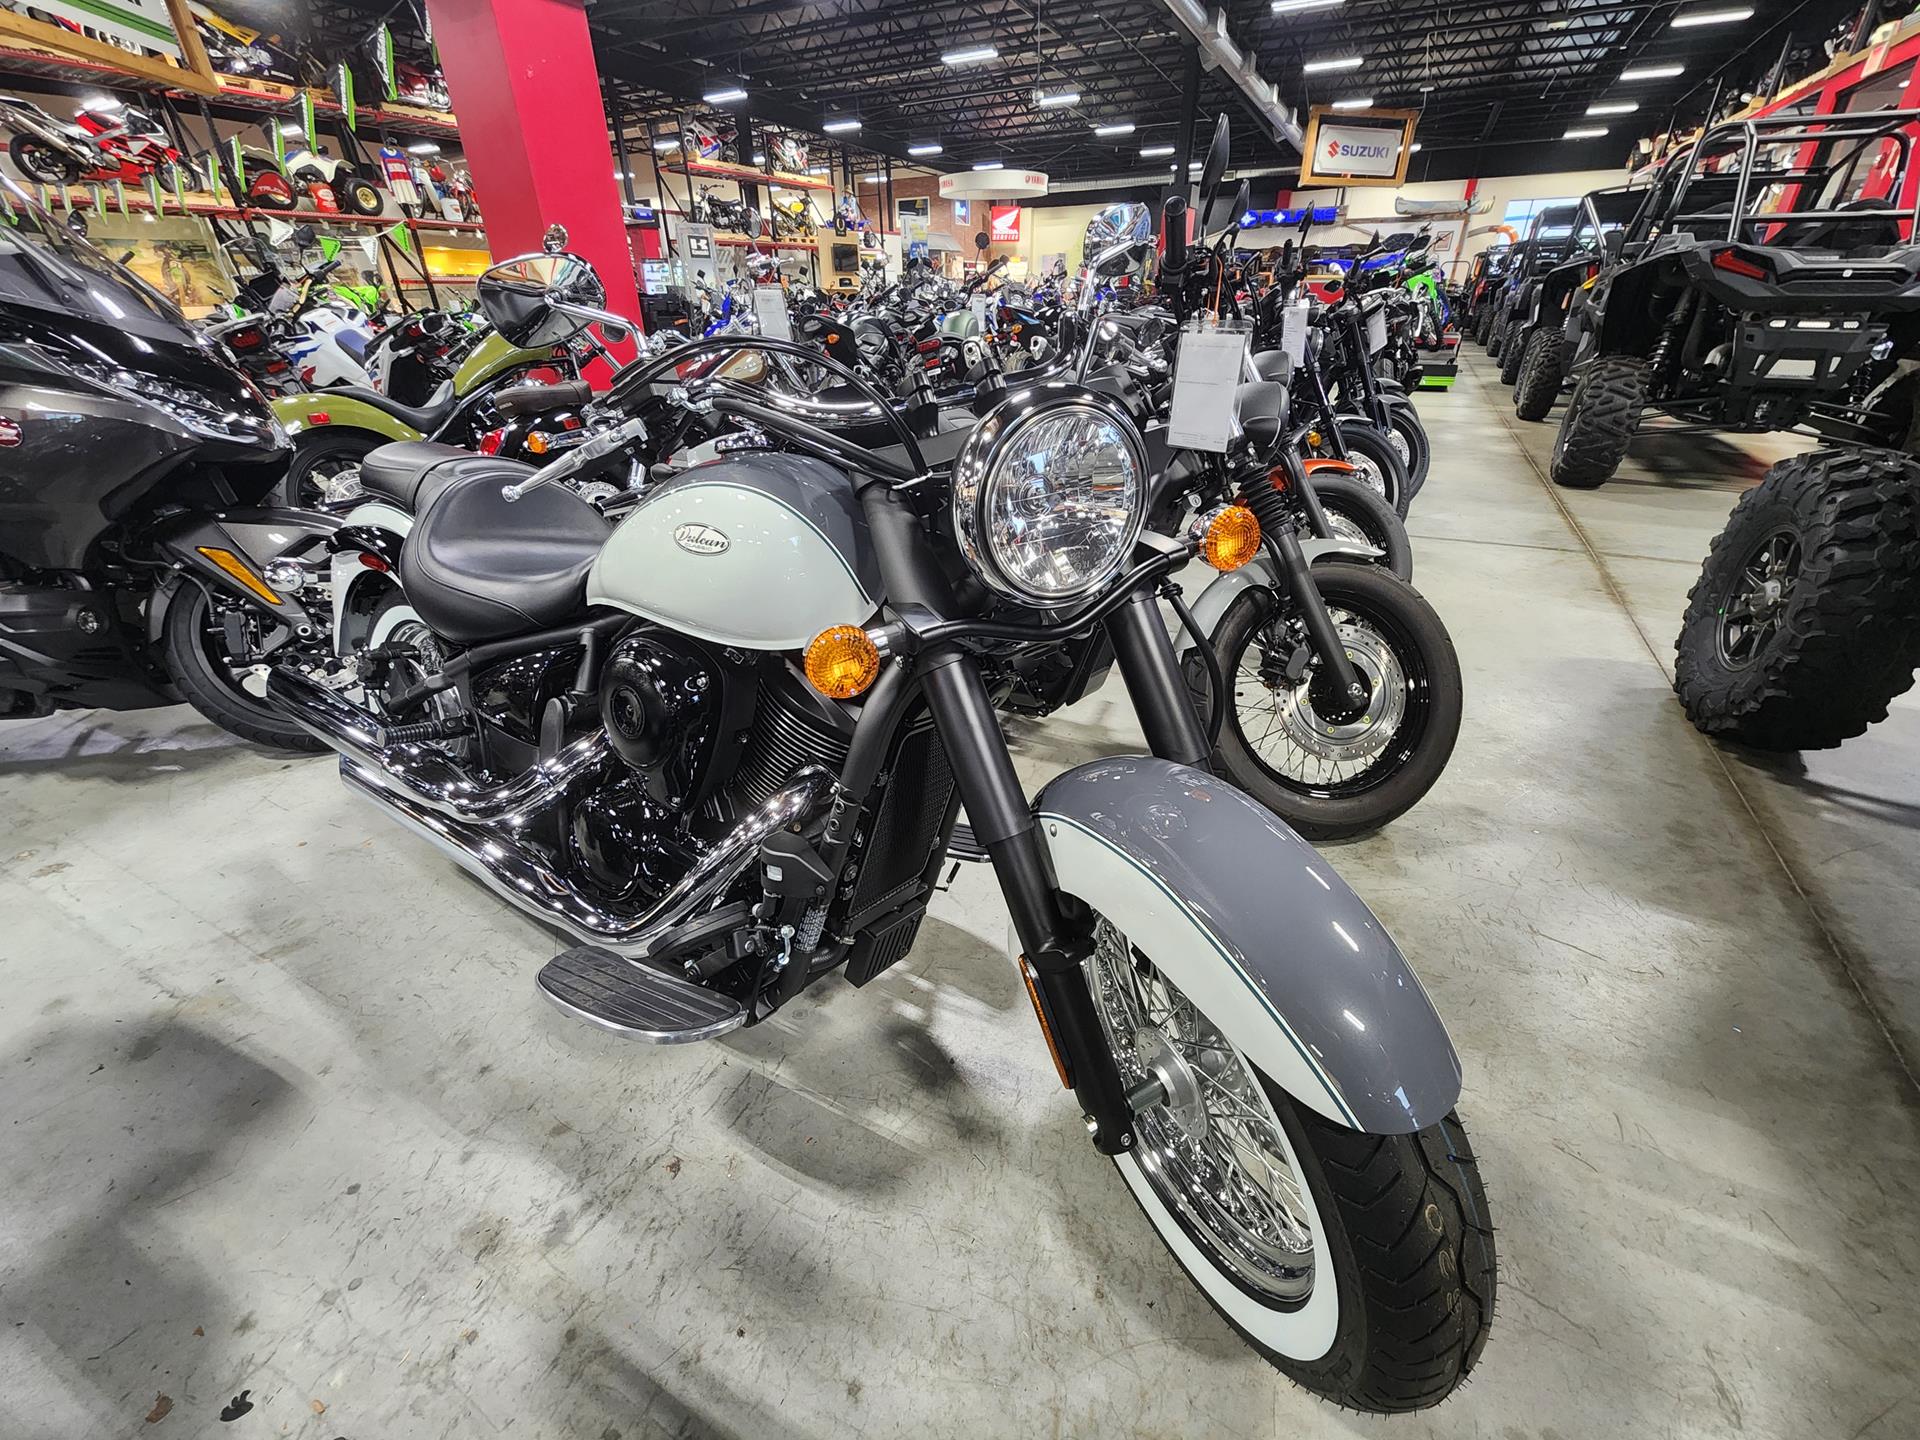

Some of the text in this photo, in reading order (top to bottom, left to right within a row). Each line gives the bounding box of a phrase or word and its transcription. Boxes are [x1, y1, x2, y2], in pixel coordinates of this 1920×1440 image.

[338, 64, 348, 116] Kawasaki
[301, 93, 310, 142] Kawasaki
[1340, 144, 1390, 159] SUZUKI
[678, 527, 727, 549] Vulcan
[685, 543, 713, 552] CLASSIC
